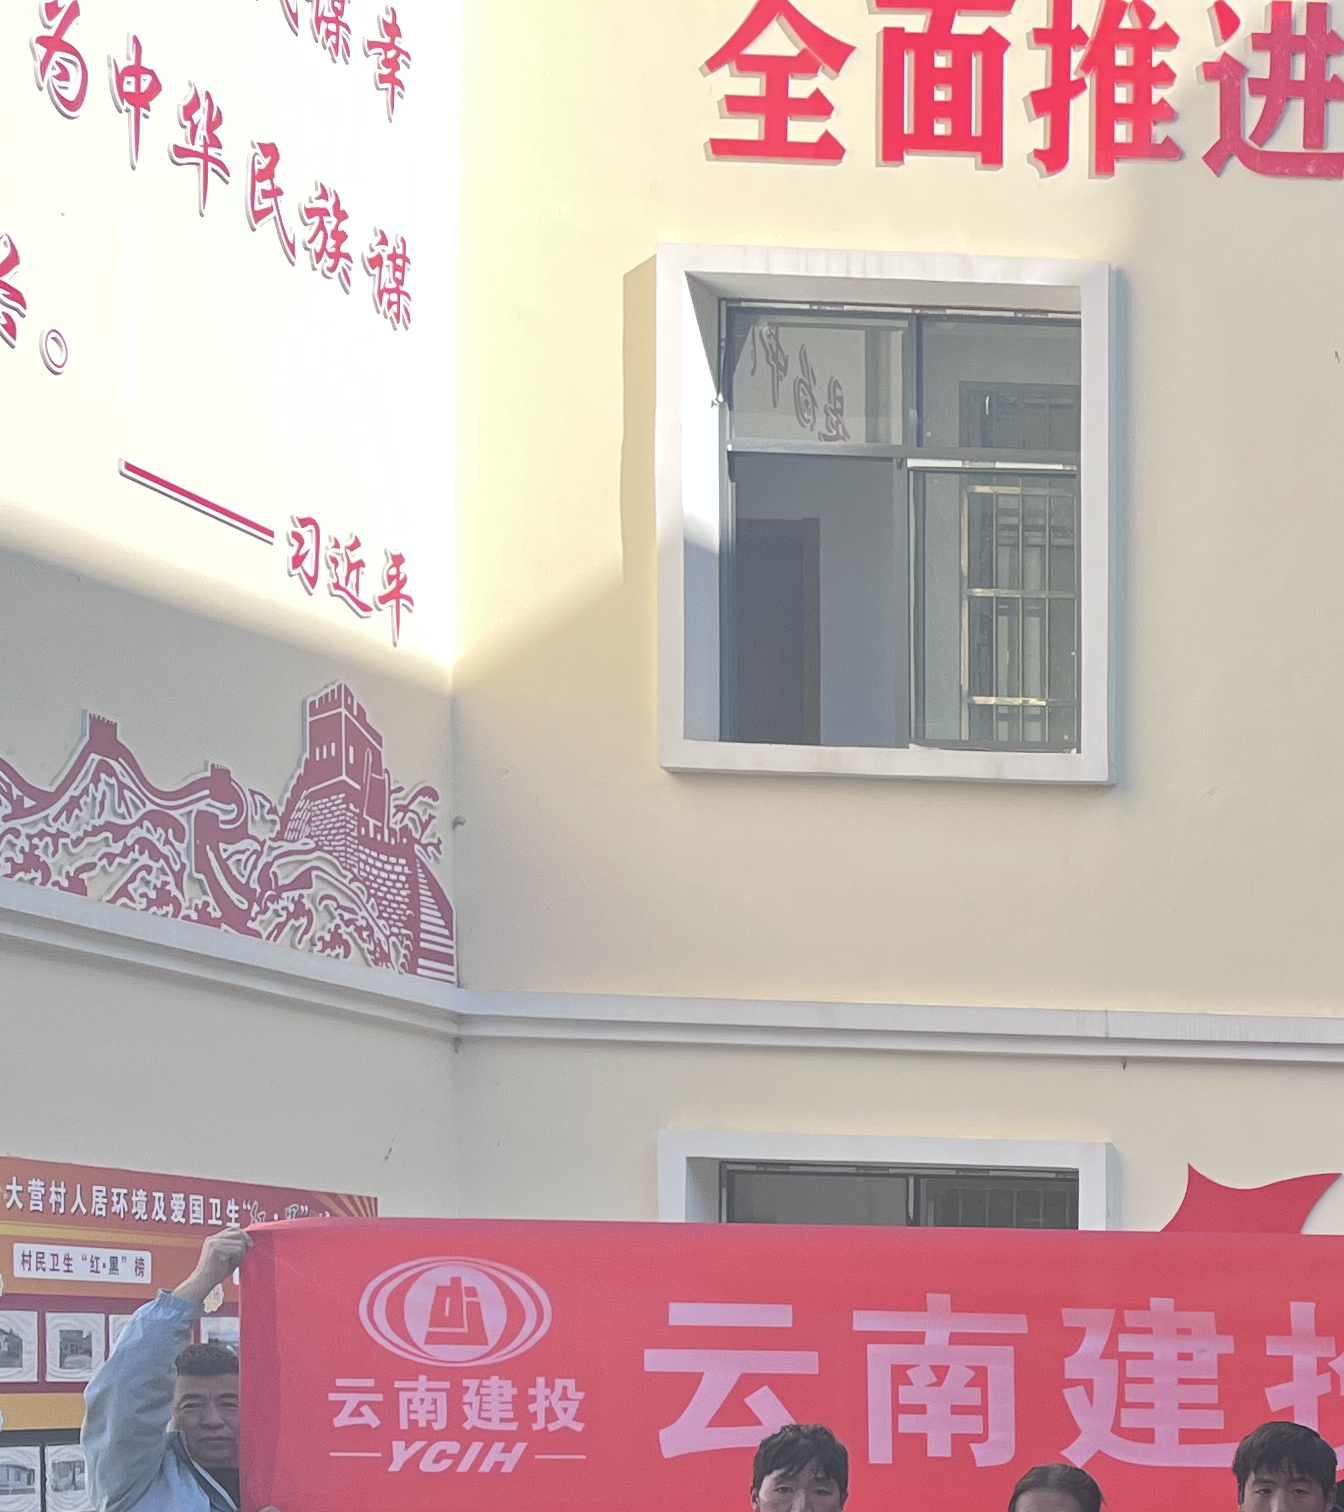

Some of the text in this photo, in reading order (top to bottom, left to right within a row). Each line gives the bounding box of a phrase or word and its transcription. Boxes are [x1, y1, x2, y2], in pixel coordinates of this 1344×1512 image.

[285, 513, 415, 646] 习近平
[326, 1375, 587, 1433] 云南建投
[387, 1439, 528, 1474] YCIH
